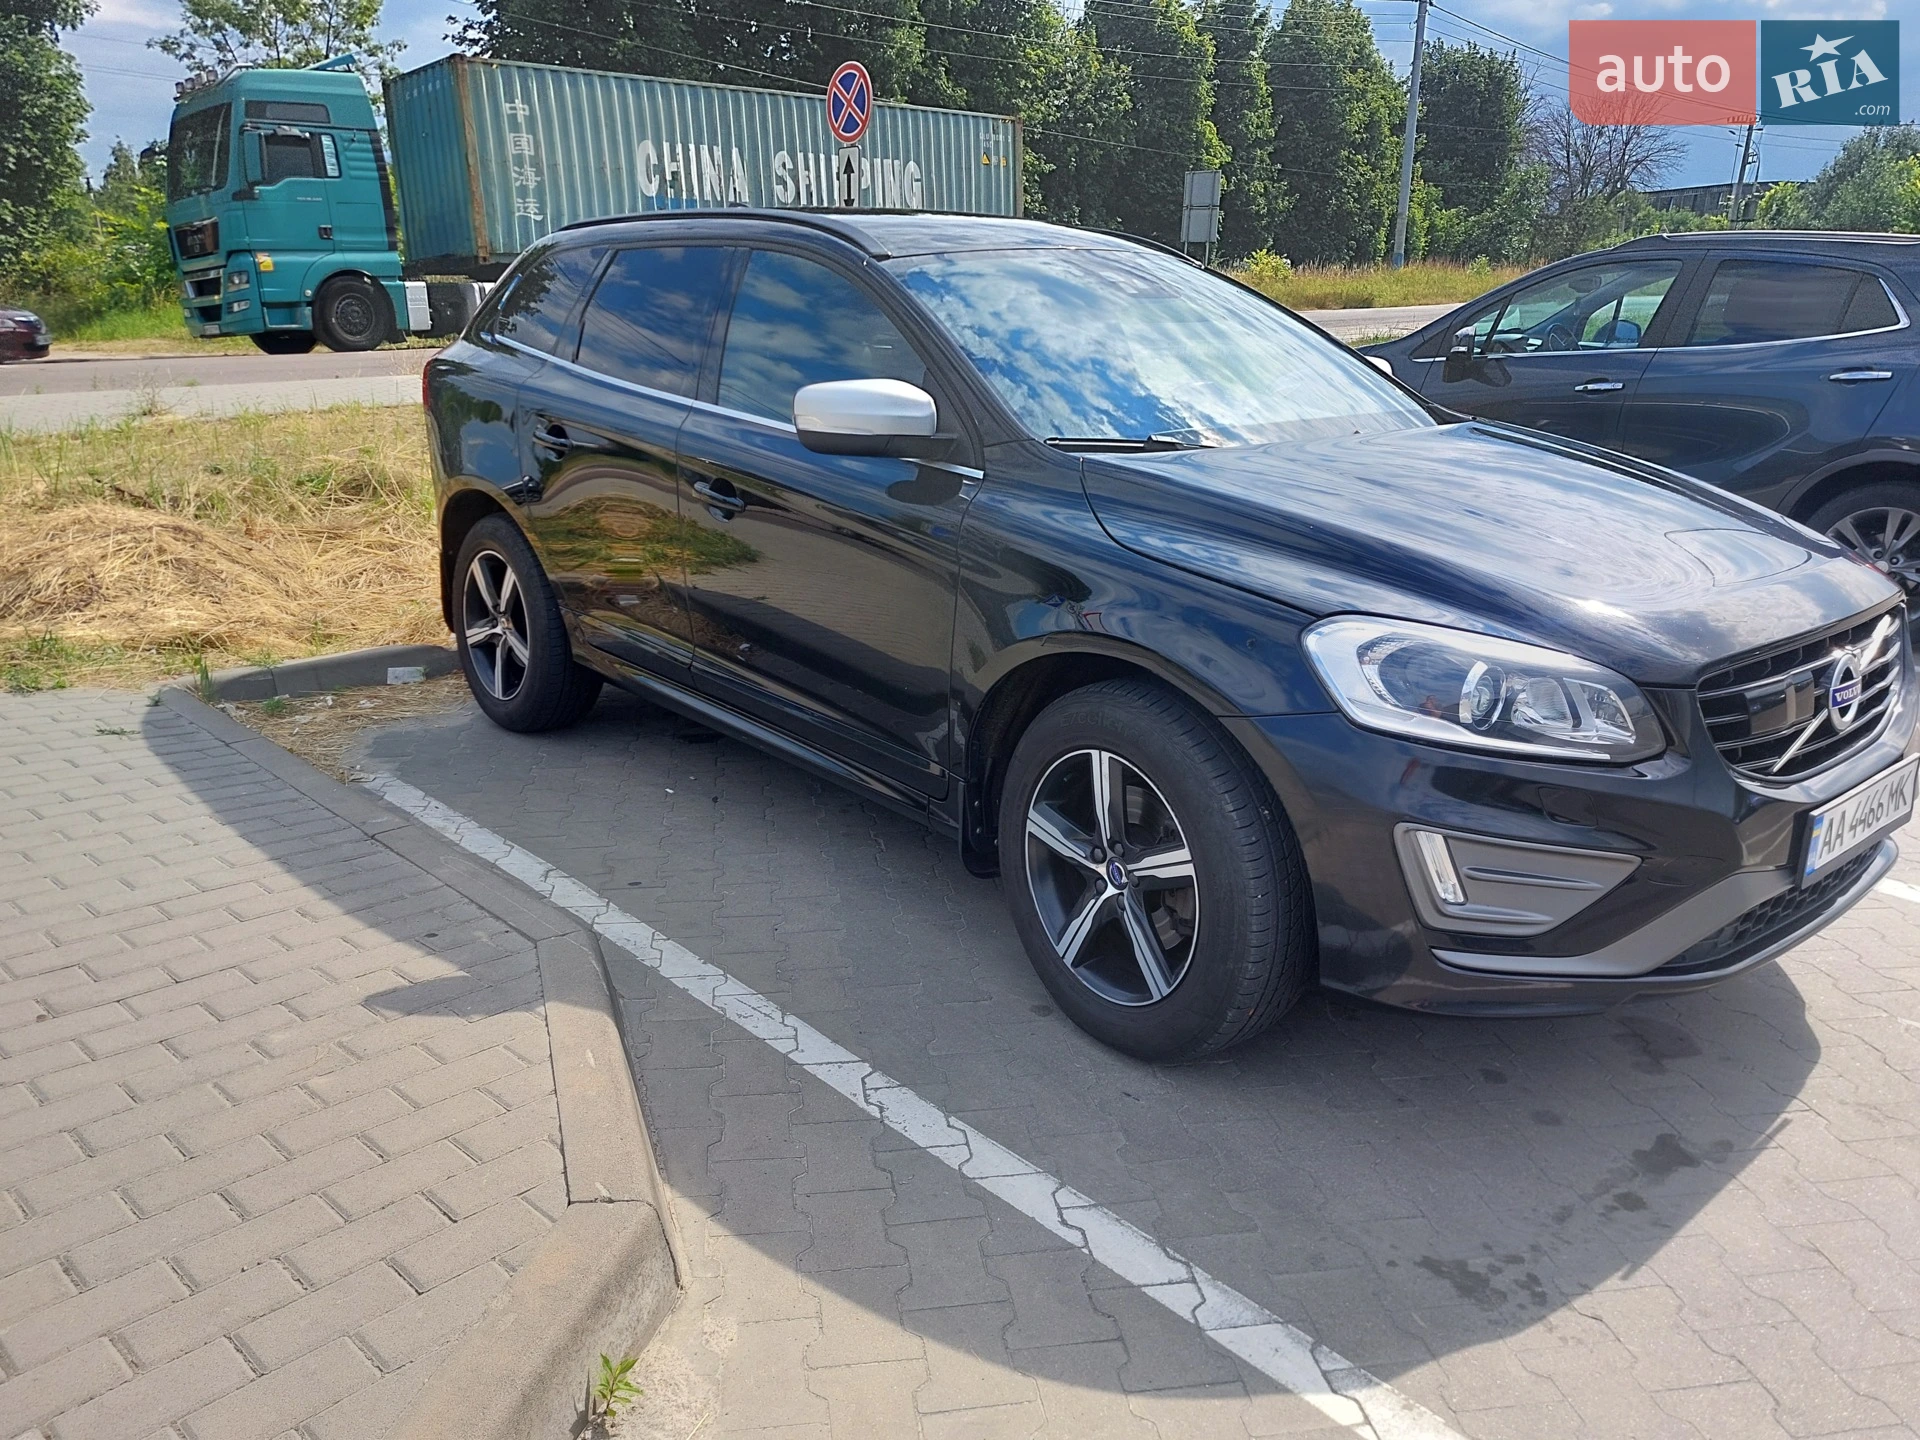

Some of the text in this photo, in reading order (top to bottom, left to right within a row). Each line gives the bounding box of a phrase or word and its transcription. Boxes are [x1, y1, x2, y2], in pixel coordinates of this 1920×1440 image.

[505, 99, 544, 221] 中国海运
[637, 139, 750, 202] CHINA
[1819, 770, 1913, 859] AA 4466 MK
